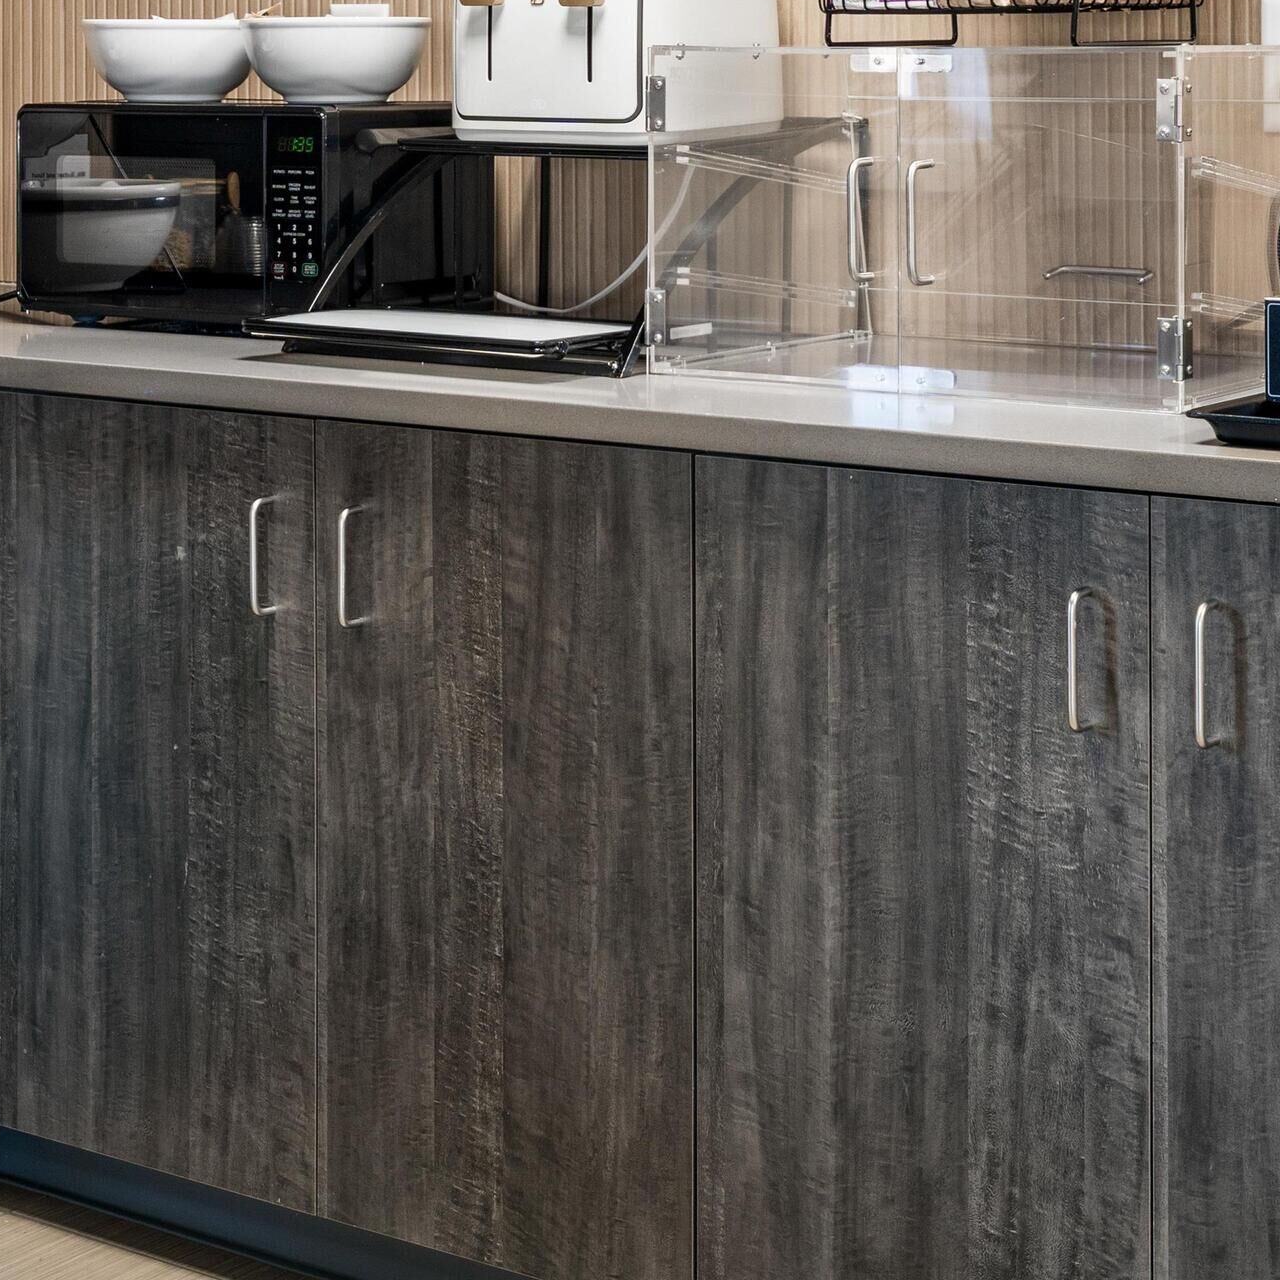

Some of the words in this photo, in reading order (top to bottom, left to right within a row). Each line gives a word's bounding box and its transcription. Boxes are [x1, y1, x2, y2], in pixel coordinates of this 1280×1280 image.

[277, 223, 281, 231] 1
[308, 224, 313, 232] 3
[308, 238, 313, 246] 6
[277, 250, 281, 258] 7
[292, 251, 297, 259] 8
[308, 252, 313, 260] 9
